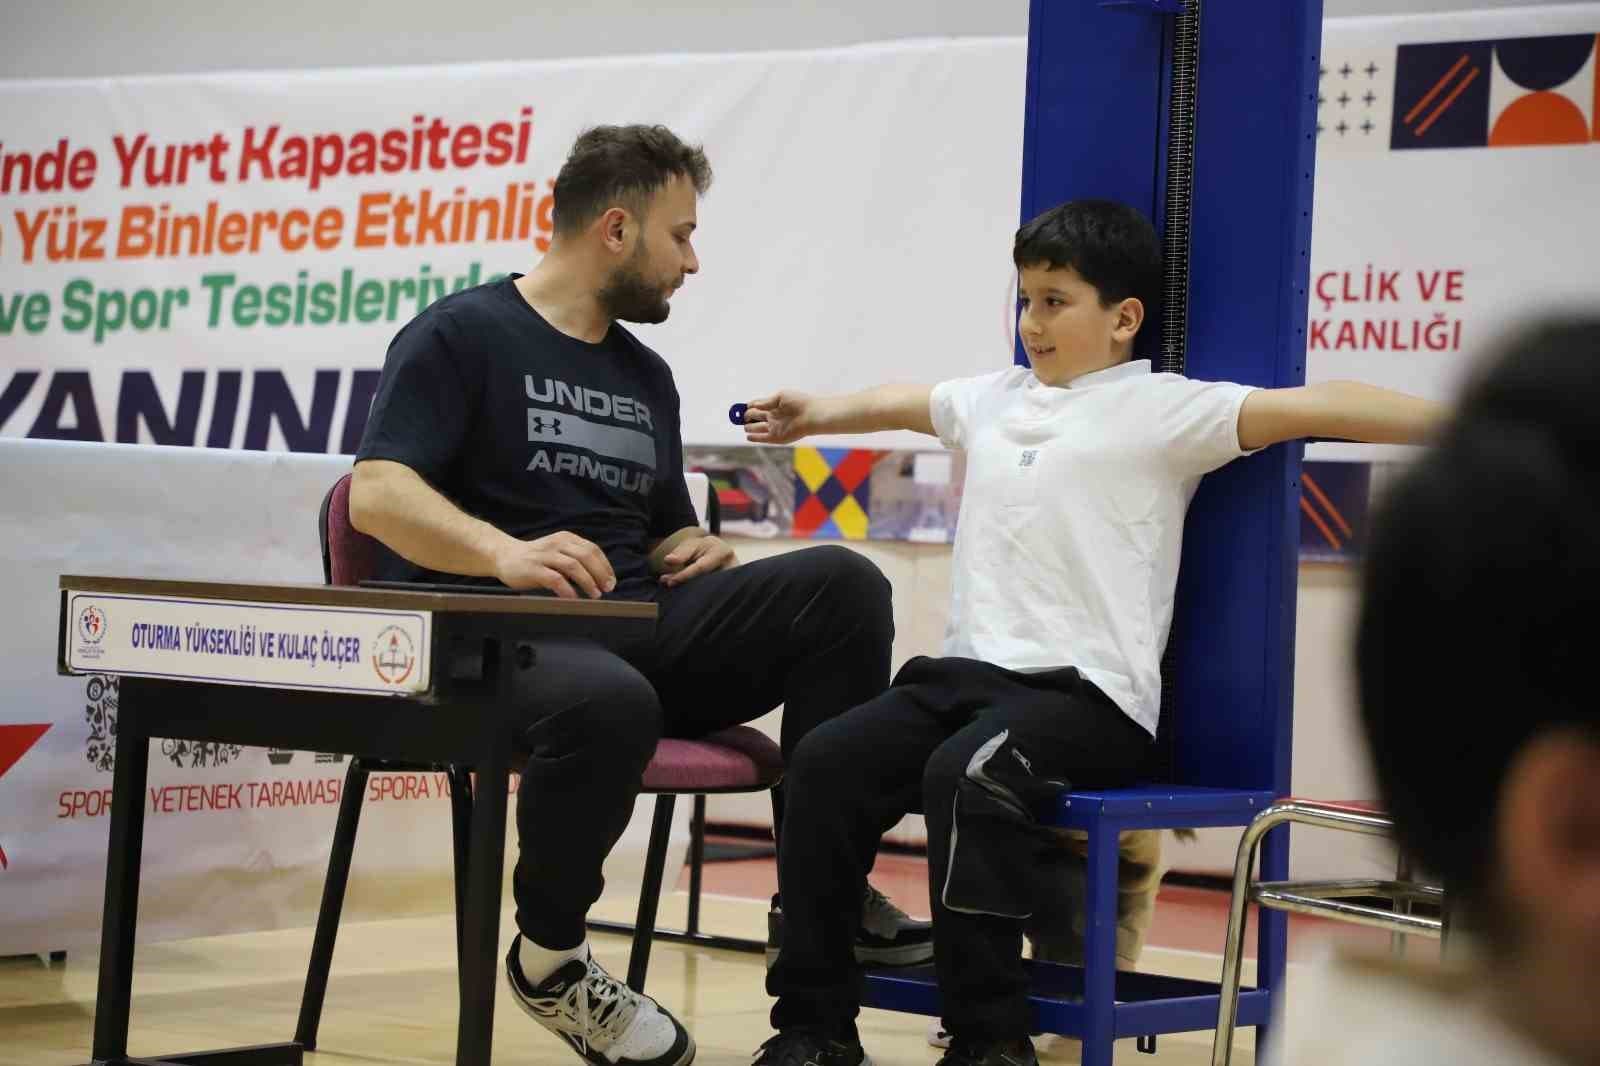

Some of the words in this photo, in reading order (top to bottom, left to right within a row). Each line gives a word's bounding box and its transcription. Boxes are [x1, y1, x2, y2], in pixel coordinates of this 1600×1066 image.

[0, 139, 97, 194] nde
[112, 133, 230, 189] Yurt
[238, 106, 533, 190] Kapasitesi
[13, 204, 108, 264] Yüz
[116, 200, 345, 258] Binlerce
[0, 292, 51, 335] ve
[61, 277, 190, 344] Spor
[201, 261, 508, 328] Tesisleri
[1315, 263, 1399, 312] ÇLİK
[1416, 269, 1465, 302] VE
[1309, 312, 1462, 351] KANLIĞI
[524, 374, 654, 430] UNDER
[131, 621, 181, 651] OTURMA
[185, 622, 257, 657] YÜKSEKLİĞİ
[259, 632, 274, 658] VE
[278, 632, 318, 668] KULAÇ
[321, 629, 361, 669] ÖLÇER
[57, 789, 113, 818] SPOR
[149, 783, 244, 813] YETENEK
[247, 778, 342, 808] TARAMASI
[369, 774, 431, 801] SPORA
